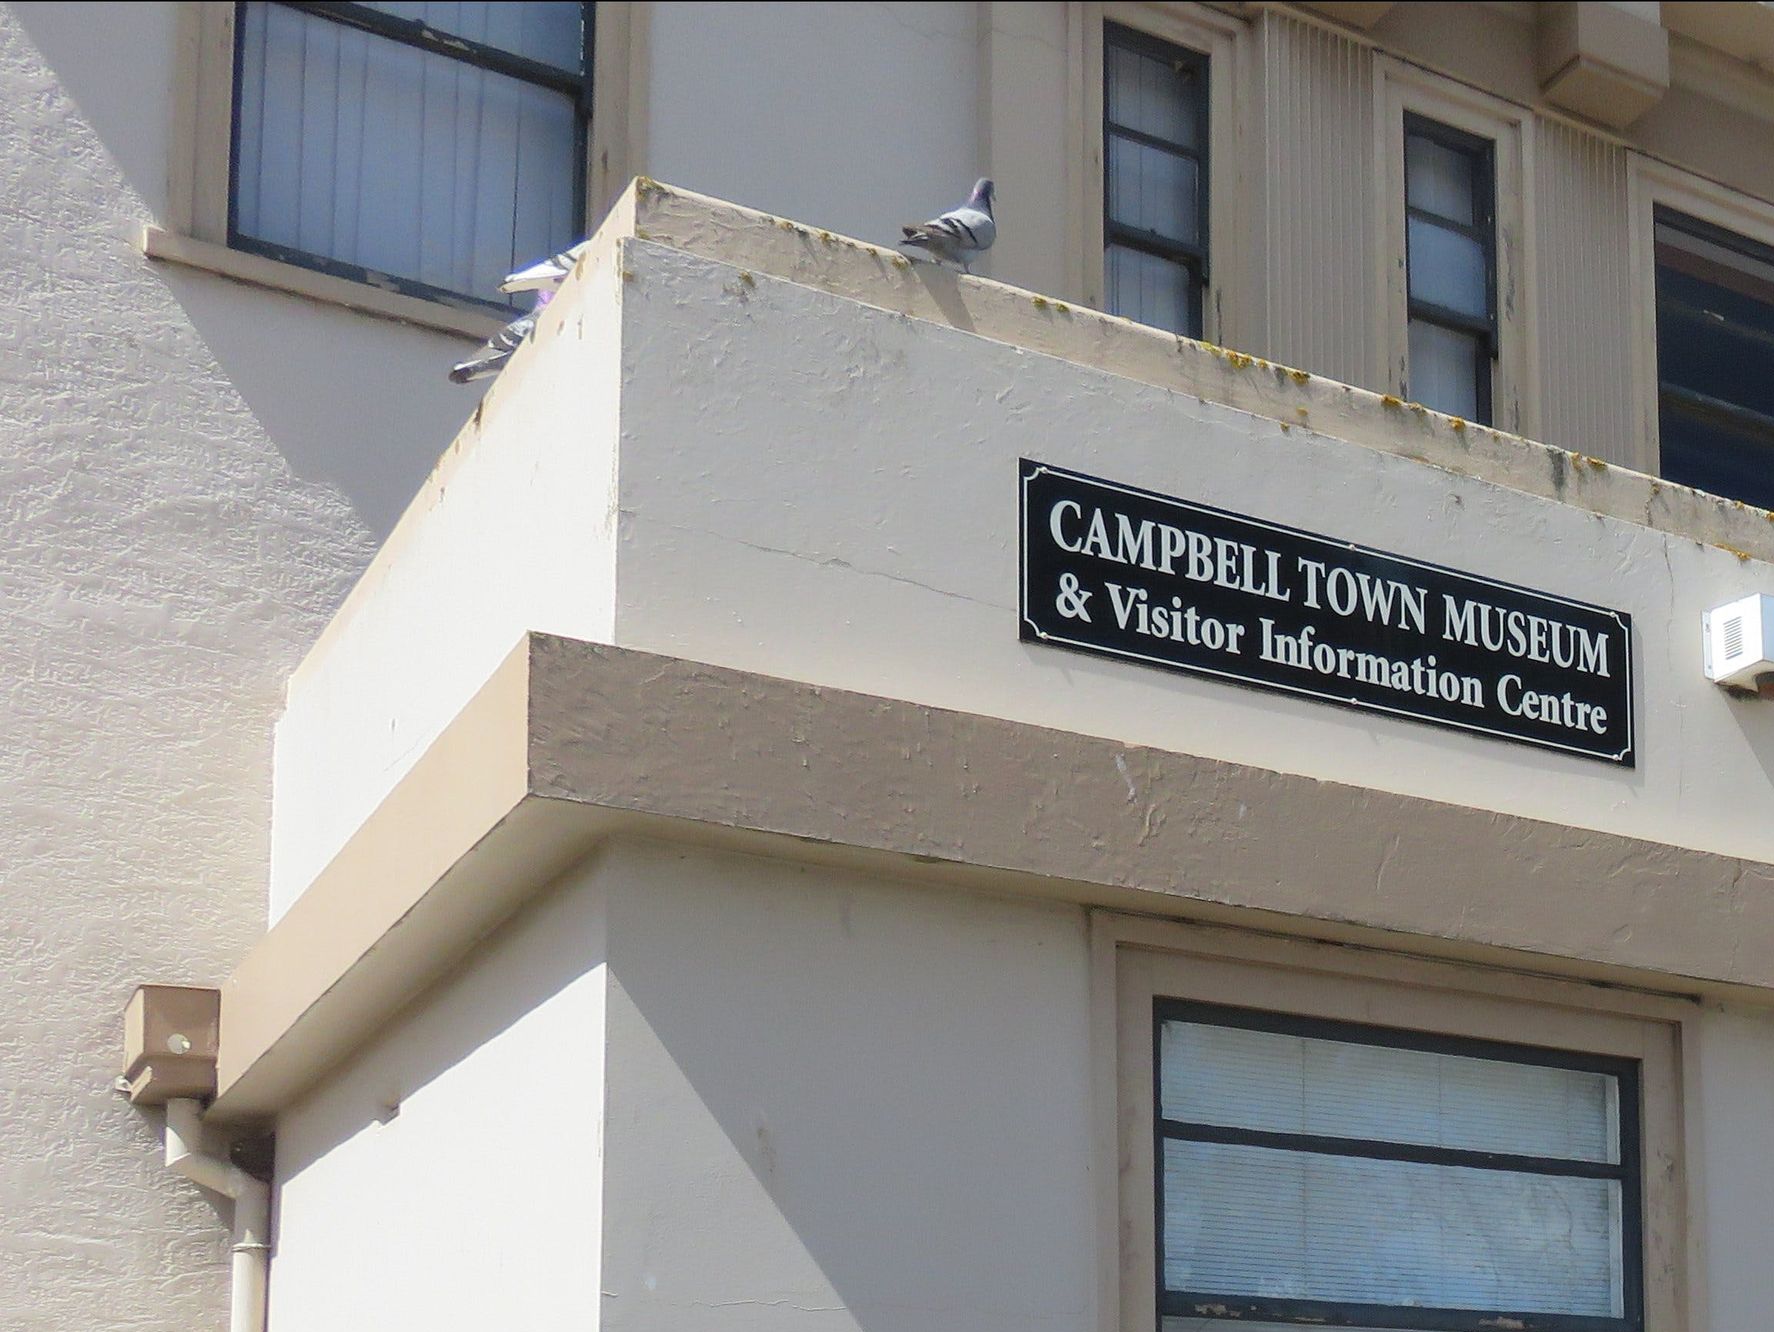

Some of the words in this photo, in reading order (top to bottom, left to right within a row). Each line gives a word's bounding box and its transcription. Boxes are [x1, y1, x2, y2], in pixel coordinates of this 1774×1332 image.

[1049, 500, 1291, 602] CAMPBELL
[1298, 557, 1427, 635] TOWN
[1442, 594, 1611, 678] MUSEUM
[1055, 573, 1093, 624] &
[1104, 581, 1245, 655] Visitor
[1259, 617, 1484, 708] Information
[1496, 674, 1608, 735] Centre
